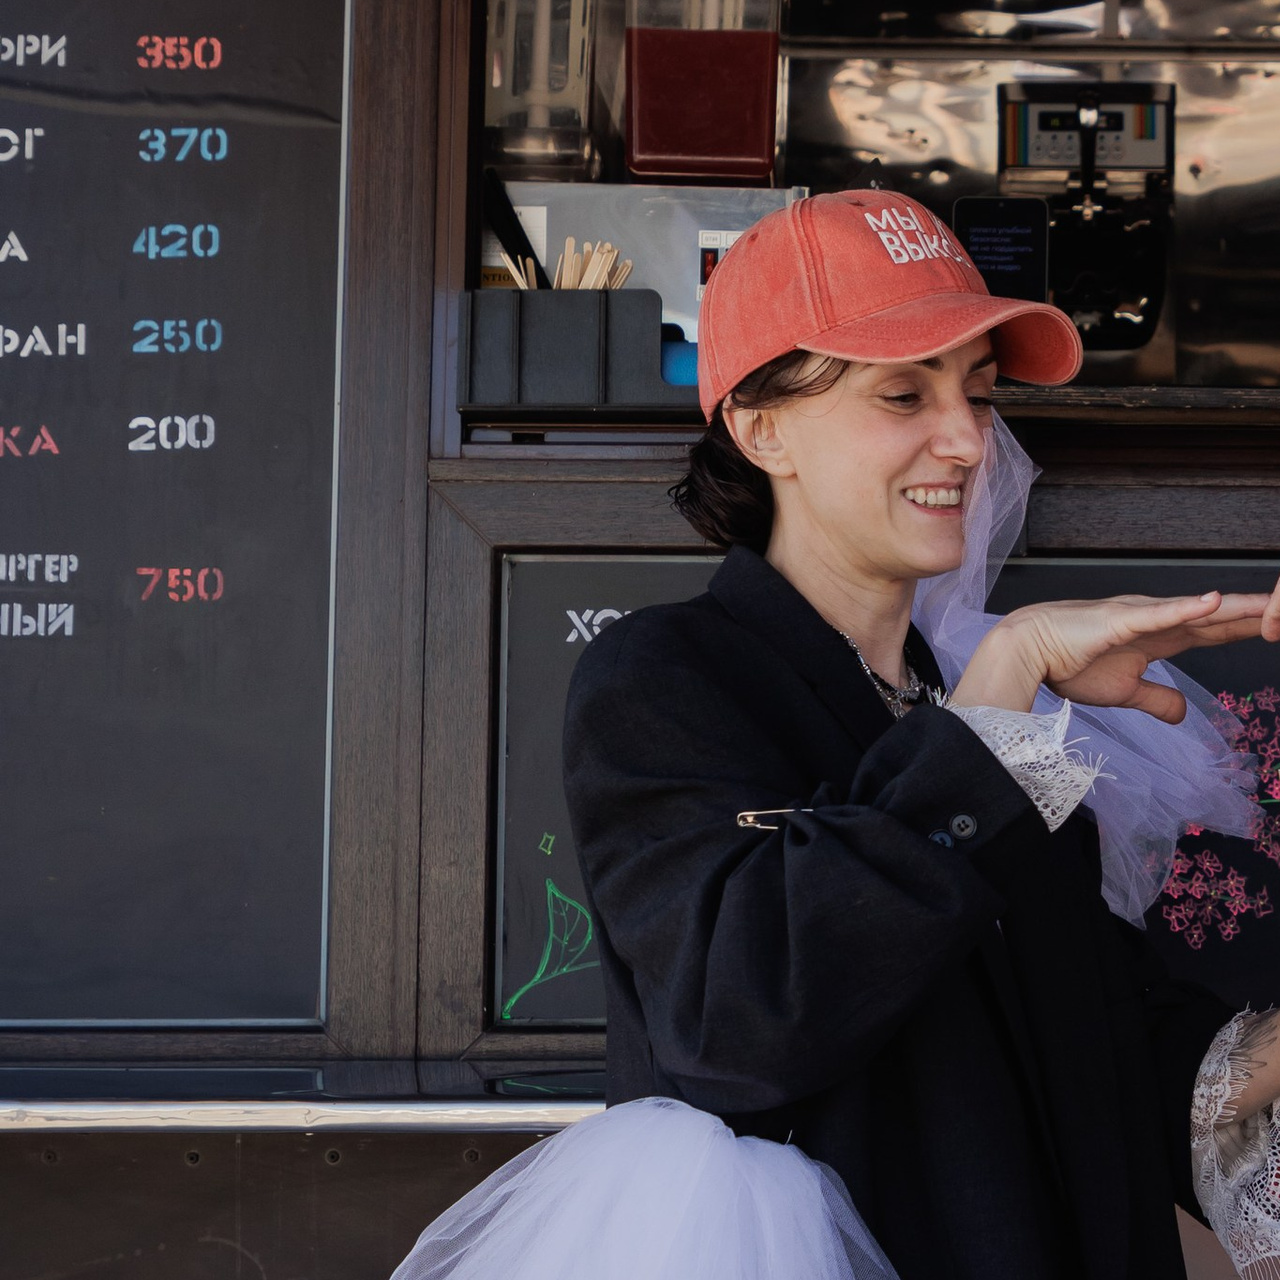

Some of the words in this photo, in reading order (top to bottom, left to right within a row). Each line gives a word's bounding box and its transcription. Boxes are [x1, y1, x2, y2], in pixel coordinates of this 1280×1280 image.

[136, 35, 223, 70] 350
[138, 127, 229, 162] 370
[863, 206, 925, 234] МЫ
[132, 223, 221, 260] 420
[132, 318, 223, 354] 250
[128, 414, 216, 451] 200
[136, 567, 225, 603] 750
